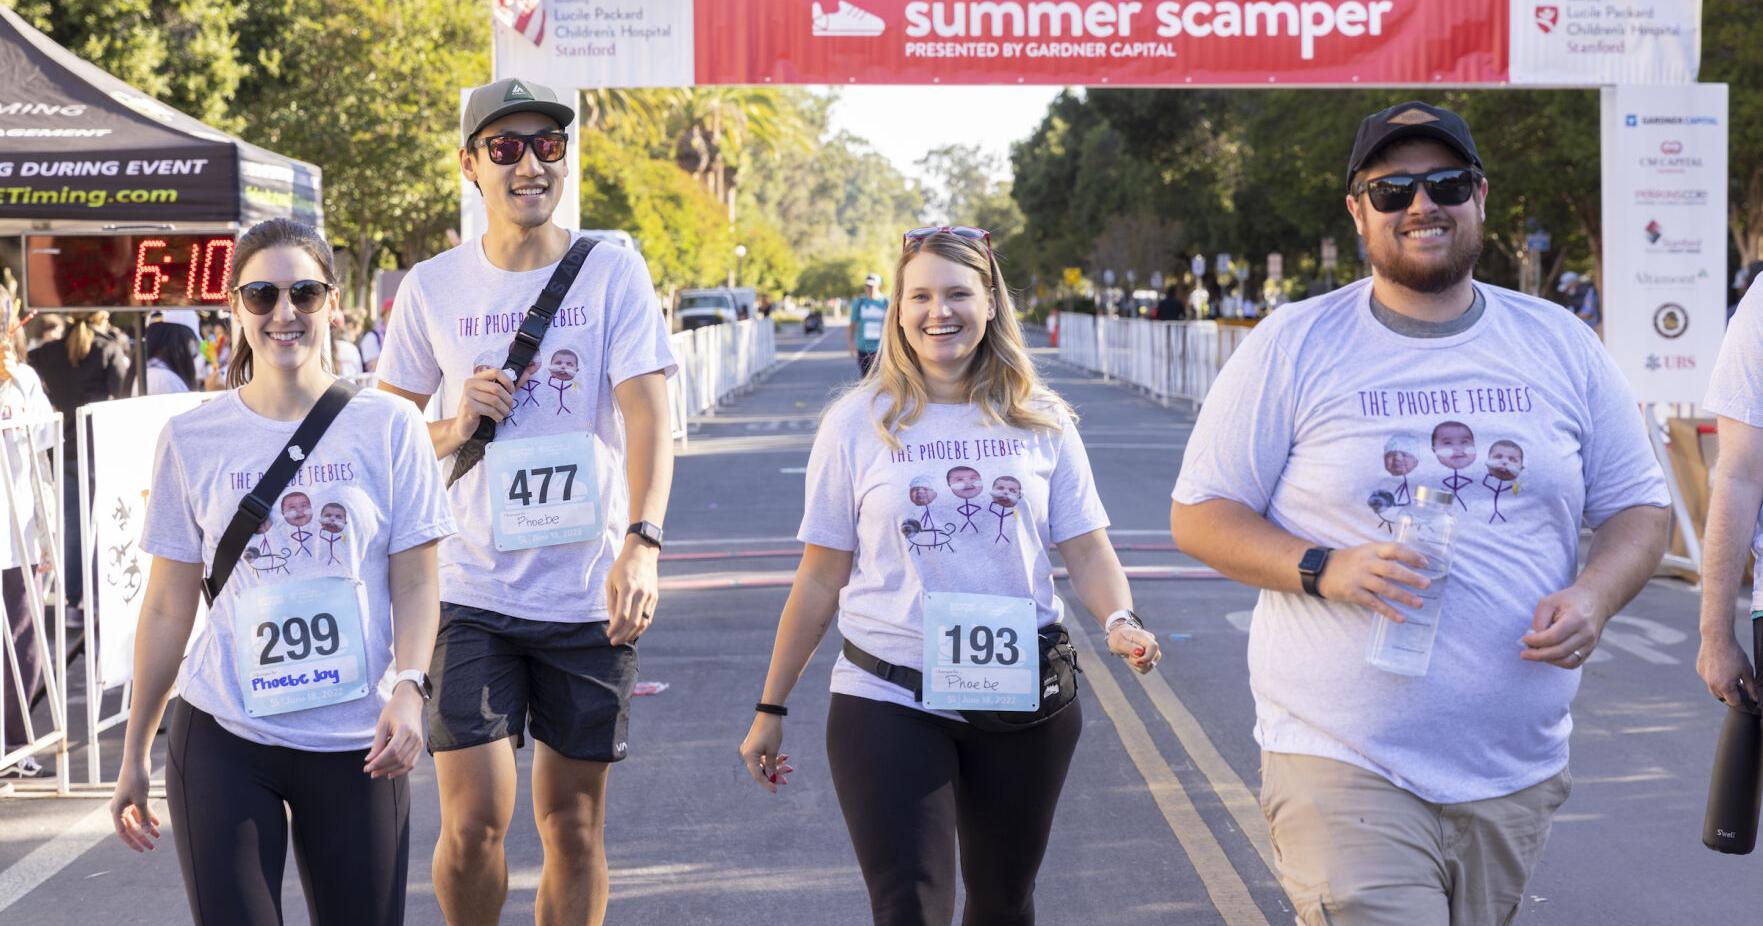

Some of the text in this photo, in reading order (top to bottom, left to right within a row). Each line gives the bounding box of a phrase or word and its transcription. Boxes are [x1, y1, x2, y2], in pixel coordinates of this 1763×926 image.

[553, 7, 643, 22] Lucile Packard
[620, 25, 672, 41] Hospital
[904, 0, 1394, 60] summer scamper
[555, 43, 617, 57] Stanford
[904, 42, 1177, 58] PRESENTED BY GARDNER CAPITAL
[20, 160, 121, 177] DURING
[125, 158, 209, 176] EVENT
[132, 239, 235, 301] 6:10
[458, 316, 480, 337] THE
[1358, 386, 1532, 417] THE PHOEBE JEEBIES
[919, 440, 970, 461] PHOEBE
[975, 438, 1025, 461] JEEBIE
[229, 471, 252, 490] THE
[308, 462, 354, 487] JEEBIES
[508, 463, 578, 506] 477
[517, 513, 560, 528] Phoebe
[256, 612, 340, 666] 299
[945, 624, 1020, 666] 193
[252, 673, 310, 691] Phoebe
[312, 669, 340, 685] Joy
[944, 673, 1000, 691] Phoebe
